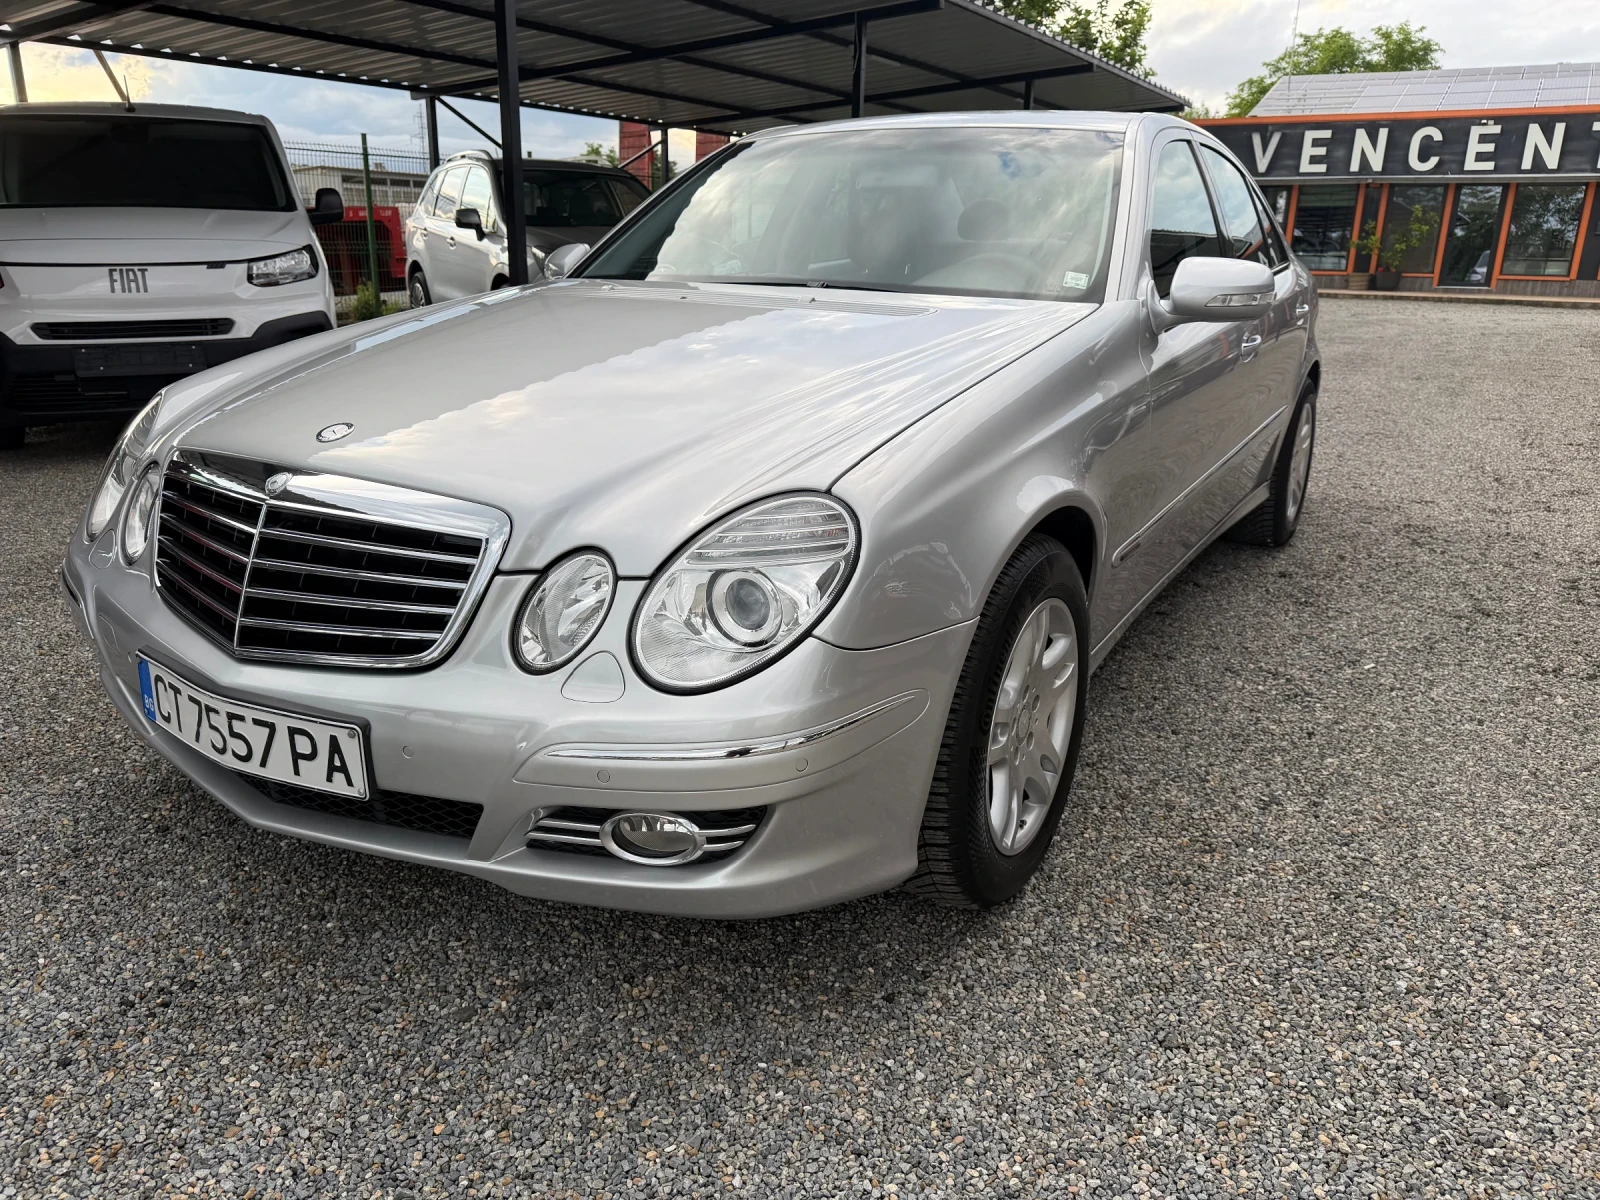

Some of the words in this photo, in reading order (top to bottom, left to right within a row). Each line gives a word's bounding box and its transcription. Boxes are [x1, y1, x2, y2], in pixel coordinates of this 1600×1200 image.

[1251, 121, 1600, 174] VENCEN
[108, 268, 148, 293] FIAT
[979, 612, 1021, 736] Continental
[144, 694, 154, 711] BG
